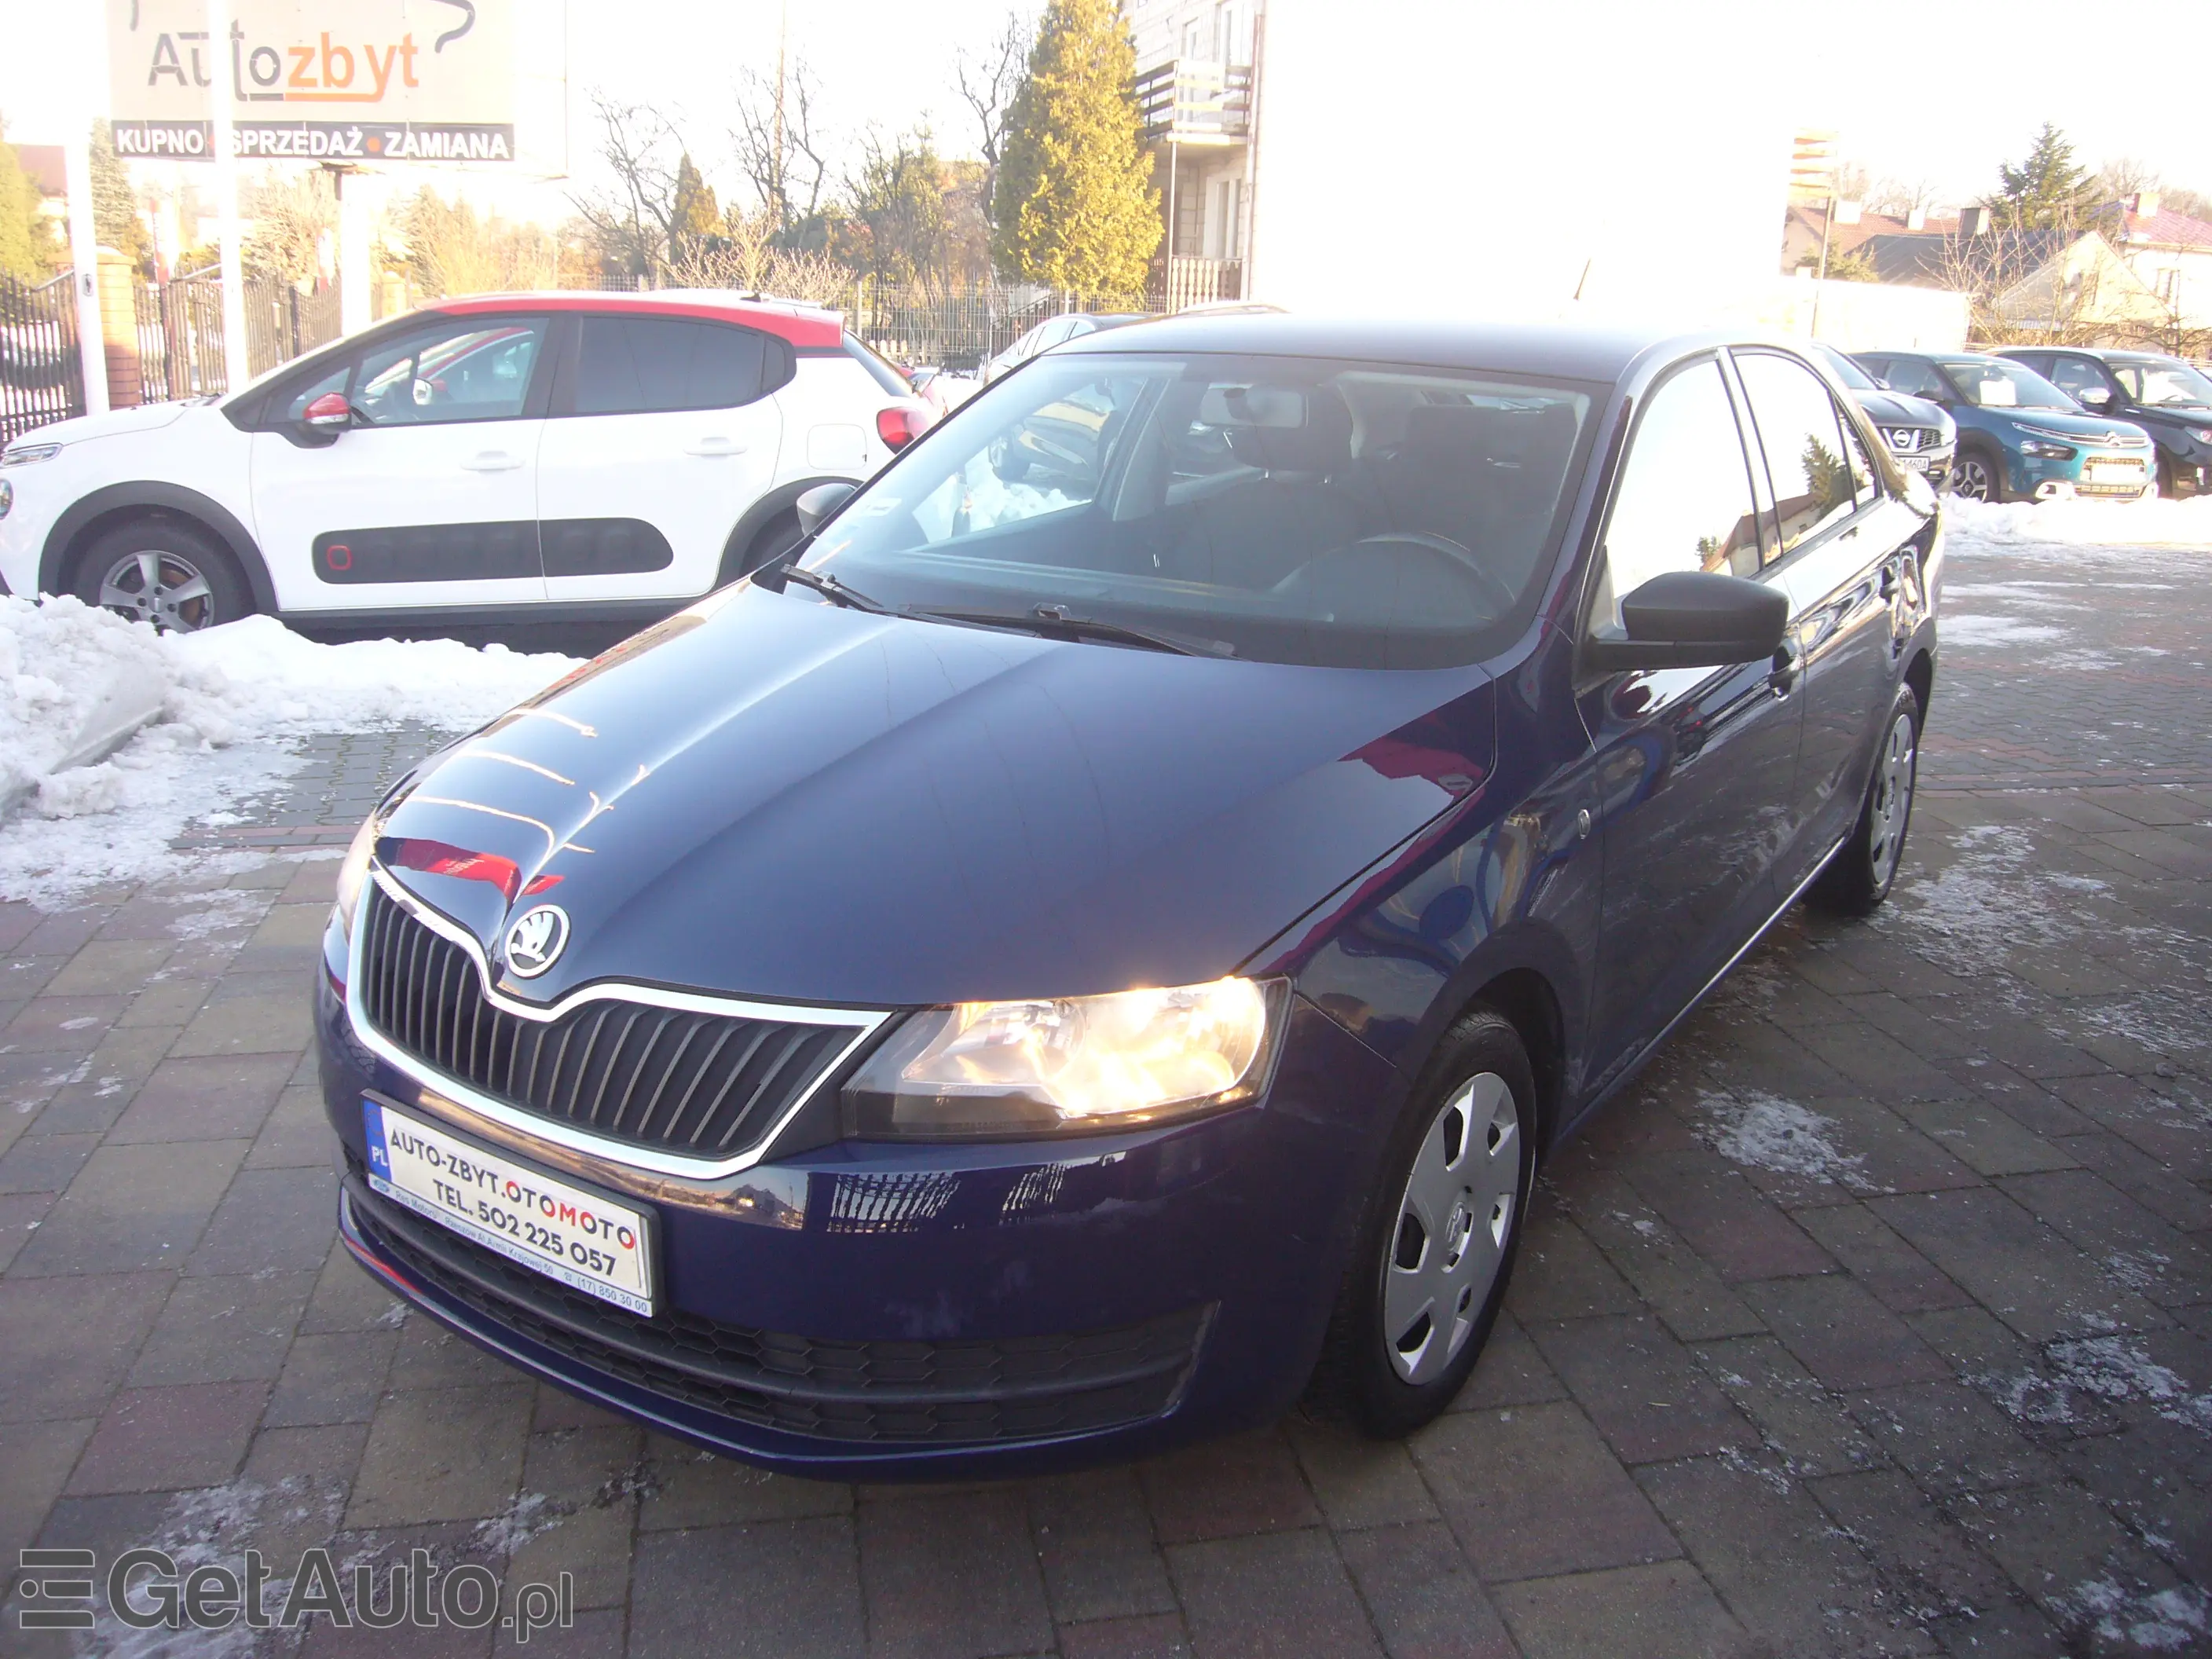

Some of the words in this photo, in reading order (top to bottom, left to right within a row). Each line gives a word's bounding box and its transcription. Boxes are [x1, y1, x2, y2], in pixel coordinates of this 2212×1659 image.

[117, 129, 204, 154] KUPNO
[384, 131, 511, 159] ZAMIANA
[372, 1145, 388, 1167] PL
[433, 1178, 474, 1216] TEL.
[478, 1199, 520, 1237] 502
[524, 1221, 564, 1256] 225
[569, 1242, 617, 1276] 057
[577, 1276, 596, 1295] (17)
[599, 1284, 617, 1301] 850
[619, 1293, 632, 1307] 30
[635, 1299, 648, 1313] 00
